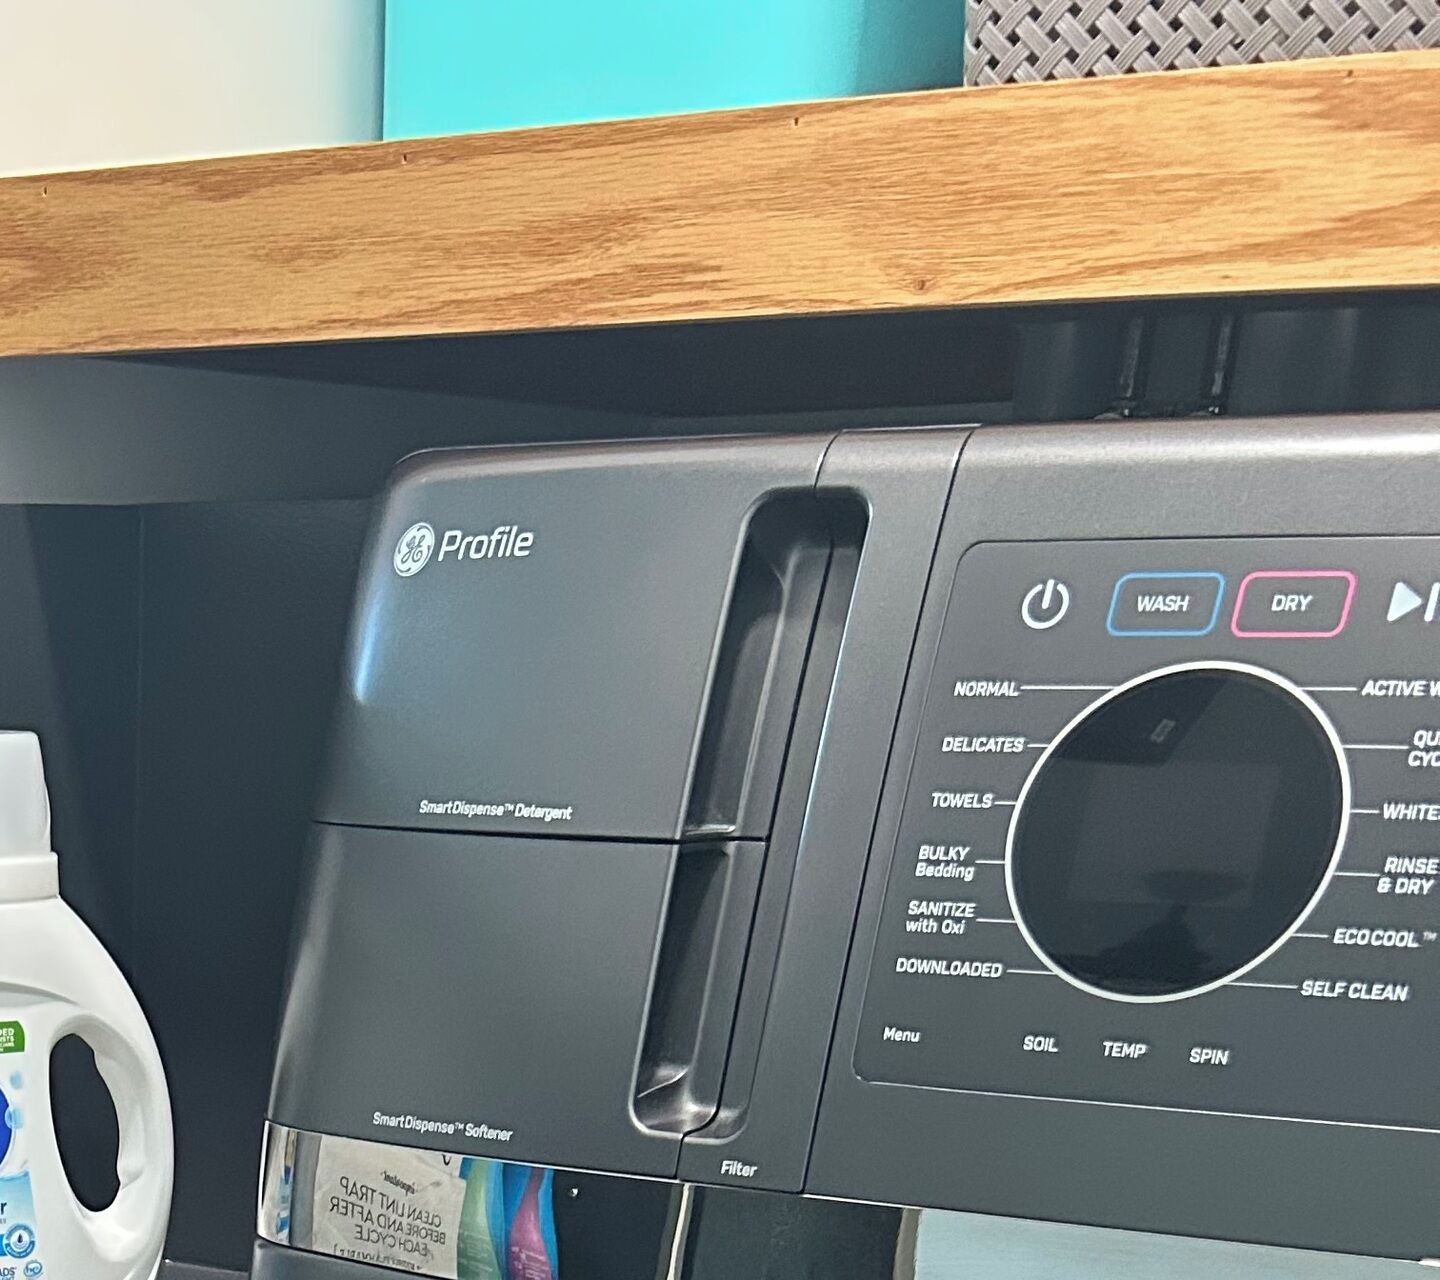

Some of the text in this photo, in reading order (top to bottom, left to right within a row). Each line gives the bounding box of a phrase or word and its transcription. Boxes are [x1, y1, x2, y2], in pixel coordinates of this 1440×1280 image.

[438, 525, 534, 561] Profile
[1137, 595, 1189, 612] WASH
[1271, 595, 1312, 612] DRY
[954, 680, 1020, 697] NORMAL
[1361, 680, 1426, 696] ACTIVE
[942, 737, 1024, 752] DELICATES
[931, 793, 993, 808] TOWELS
[514, 803, 573, 821] Detergent
[1383, 803, 1440, 820] WHITE
[919, 845, 970, 861] BULKY
[915, 863, 974, 881] Bedding
[1384, 857, 1440, 874] RINSE
[1377, 878, 1434, 894] & DRY
[908, 901, 976, 917] SANITIZE
[906, 919, 965, 934] with Oxi
[896, 958, 1002, 978] DOWNLOADED
[1300, 980, 1408, 1001] SELF CLEAN
[883, 1027, 920, 1042] Menu
[1023, 1035, 1059, 1052] SOIL
[1103, 1041, 1147, 1058] TEMP
[1189, 1048, 1229, 1065] SPIN
[465, 1123, 513, 1141] Softener
[721, 1160, 758, 1177] Filter
